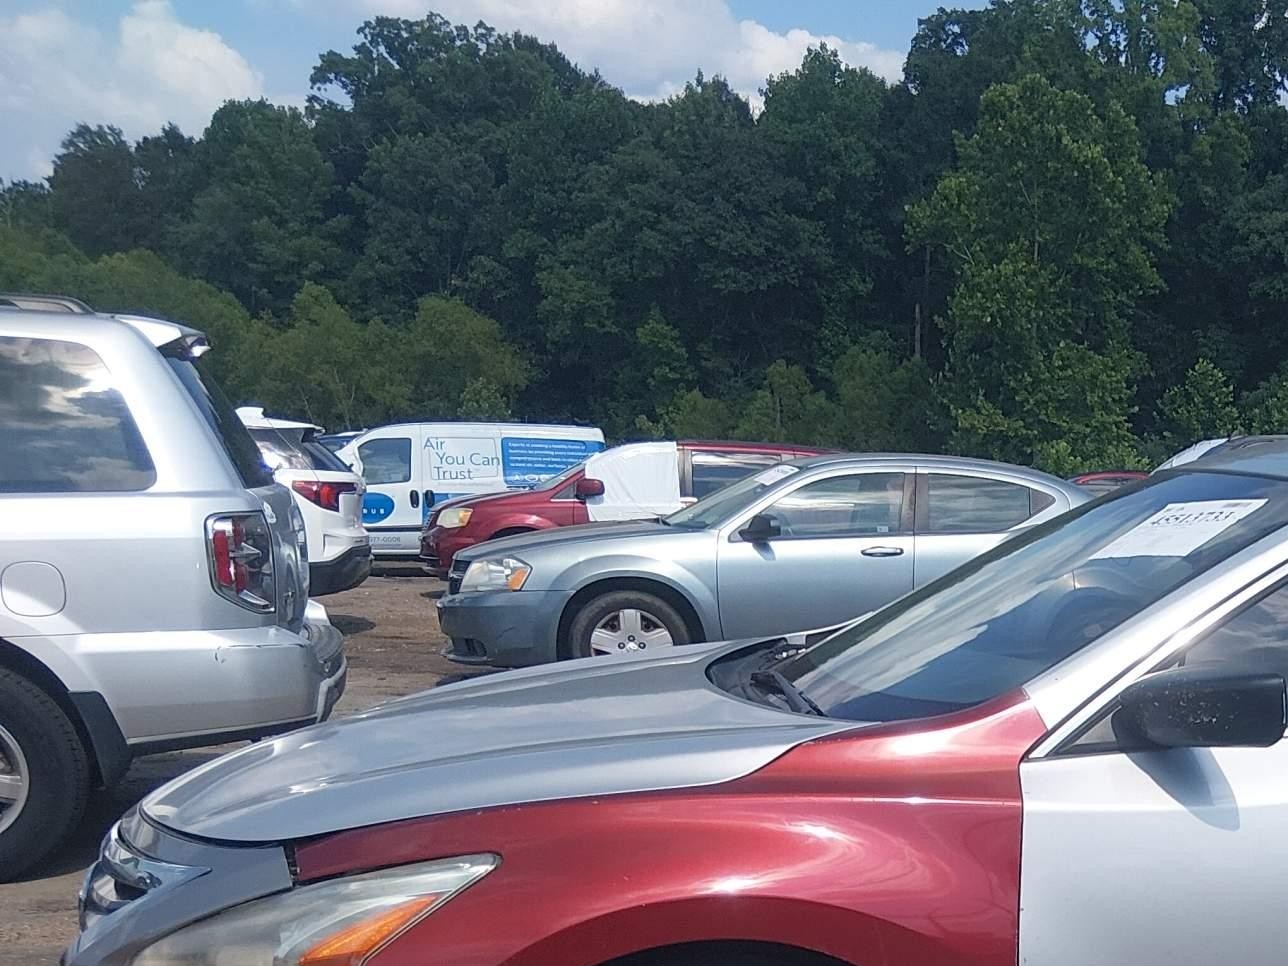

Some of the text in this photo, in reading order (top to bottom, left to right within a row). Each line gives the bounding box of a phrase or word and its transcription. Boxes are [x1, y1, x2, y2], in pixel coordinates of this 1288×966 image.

[423, 437, 446, 450] Air
[435, 451, 465, 465] You
[469, 452, 501, 466] Can
[433, 466, 473, 481] Trust
